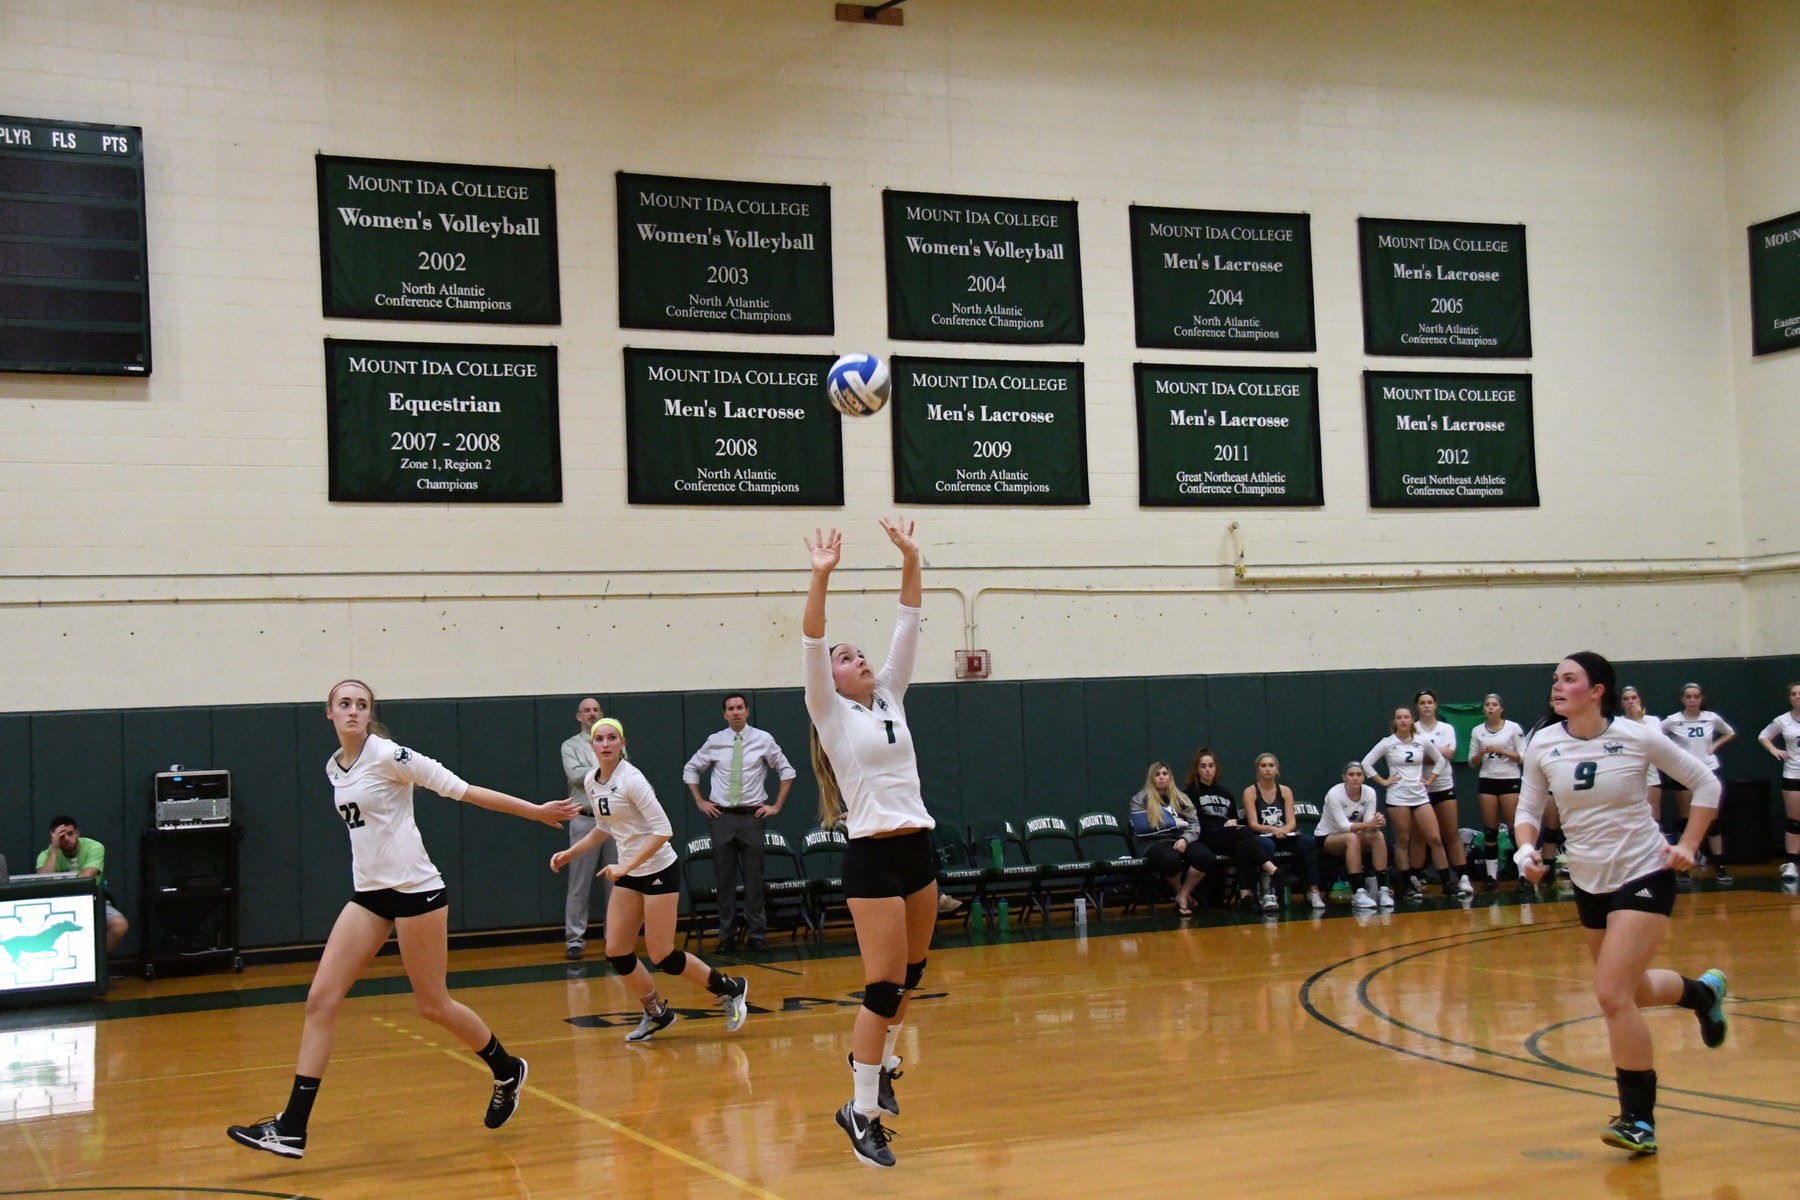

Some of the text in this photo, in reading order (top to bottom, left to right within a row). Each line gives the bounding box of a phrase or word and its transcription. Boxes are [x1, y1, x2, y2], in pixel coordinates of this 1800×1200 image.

[52, 131, 77, 149] FLS
[102, 135, 128, 153] PTS
[348, 175, 528, 200] MOUNT IDA COLLEGE
[640, 192, 809, 217] MOUNT IDA COLLEGE
[337, 207, 540, 238] Women's Volleyball
[907, 207, 1058, 227] MOUNT IDA COLLEGE
[636, 224, 814, 253] Women's Volleyball
[1150, 223, 1292, 241] MOUNT IDA COLLEGE
[906, 236, 1064, 263] Women's Volleyball
[1379, 235, 1508, 252] MOUNT IDA COLLEGE
[419, 252, 466, 271] 2002
[1164, 253, 1282, 272] Men's Lacrosse
[707, 266, 748, 285] 2003
[1393, 263, 1499, 281] Men's Lacrosse
[401, 282, 485, 296] North Atlantic
[968, 275, 1006, 292] 2004
[375, 294, 511, 312] Conference Champions
[689, 294, 769, 308] North Atlantic
[1208, 289, 1243, 305] 2004
[952, 303, 1022, 316] North Atlantic
[1431, 298, 1462, 313] 2005
[666, 306, 791, 323] Conference Champions
[932, 314, 1044, 330] Conference Champions
[1193, 315, 1259, 327] North Atlantic
[1174, 326, 1279, 340] Conference Champions
[1419, 323, 1478, 334] North Atlantic
[1401, 334, 1497, 347] Conference Champions
[349, 357, 537, 377] MOUNT IDA COLLEGE
[648, 366, 818, 385] MOUNT IDA COLLEGE
[912, 373, 1067, 391] MOUNT IDA COLLEGE
[1156, 380, 1300, 396] MOUNT IDA COLLEGE
[1383, 387, 1516, 401] MOUNT IDA COLLEGE
[389, 393, 501, 416] Equestrian
[664, 399, 804, 419] Men's Lacrosse
[927, 404, 1054, 423] Men's Lacrosse
[1170, 409, 1289, 427] Men's Lacrosse
[1396, 415, 1505, 431] Men's Lacrosse
[391, 432, 436, 451] 2007
[456, 433, 500, 451] 2008
[716, 439, 757, 456] 2008
[973, 441, 1011, 458] 2009
[1215, 445, 1248, 461] 2011
[1437, 449, 1469, 464] 2012
[401, 458, 491, 472] Zone 1, Region 2
[697, 468, 776, 480] North Atlantic
[956, 469, 1028, 480] North Atlantic
[1176, 471, 1286, 483] Great Northeast Athletic
[1402, 474, 1505, 484] Great Northeast Athletic
[417, 479, 478, 492] Champions
[674, 480, 799, 495] Conference Champions
[936, 481, 1049, 494] Conference Champions
[1179, 483, 1285, 497] Conference Champions
[1406, 485, 1503, 498] Conference Champions
[883, 720, 896, 744] 1
[1687, 727, 1704, 738] 20
[1405, 751, 1414, 763] 2
[1573, 761, 1598, 791] 9
[339, 802, 365, 829] 22
[1306, 804, 1319, 815] IDA
[1027, 818, 1051, 832] MOUNT
[1052, 818, 1066, 830] IDA
[1080, 815, 1118, 829] MOUNT IDA
[772, 833, 786, 846] IDA
[805, 831, 847, 846] MOUNT IDA
[1003, 866, 1037, 874] MUSTANGS
[1058, 863, 1091, 871] MUSTANGS
[1110, 859, 1143, 867] MUSTANGS
[947, 870, 981, 878] MUSTANGS
[769, 881, 806, 890] MUSTANGS
